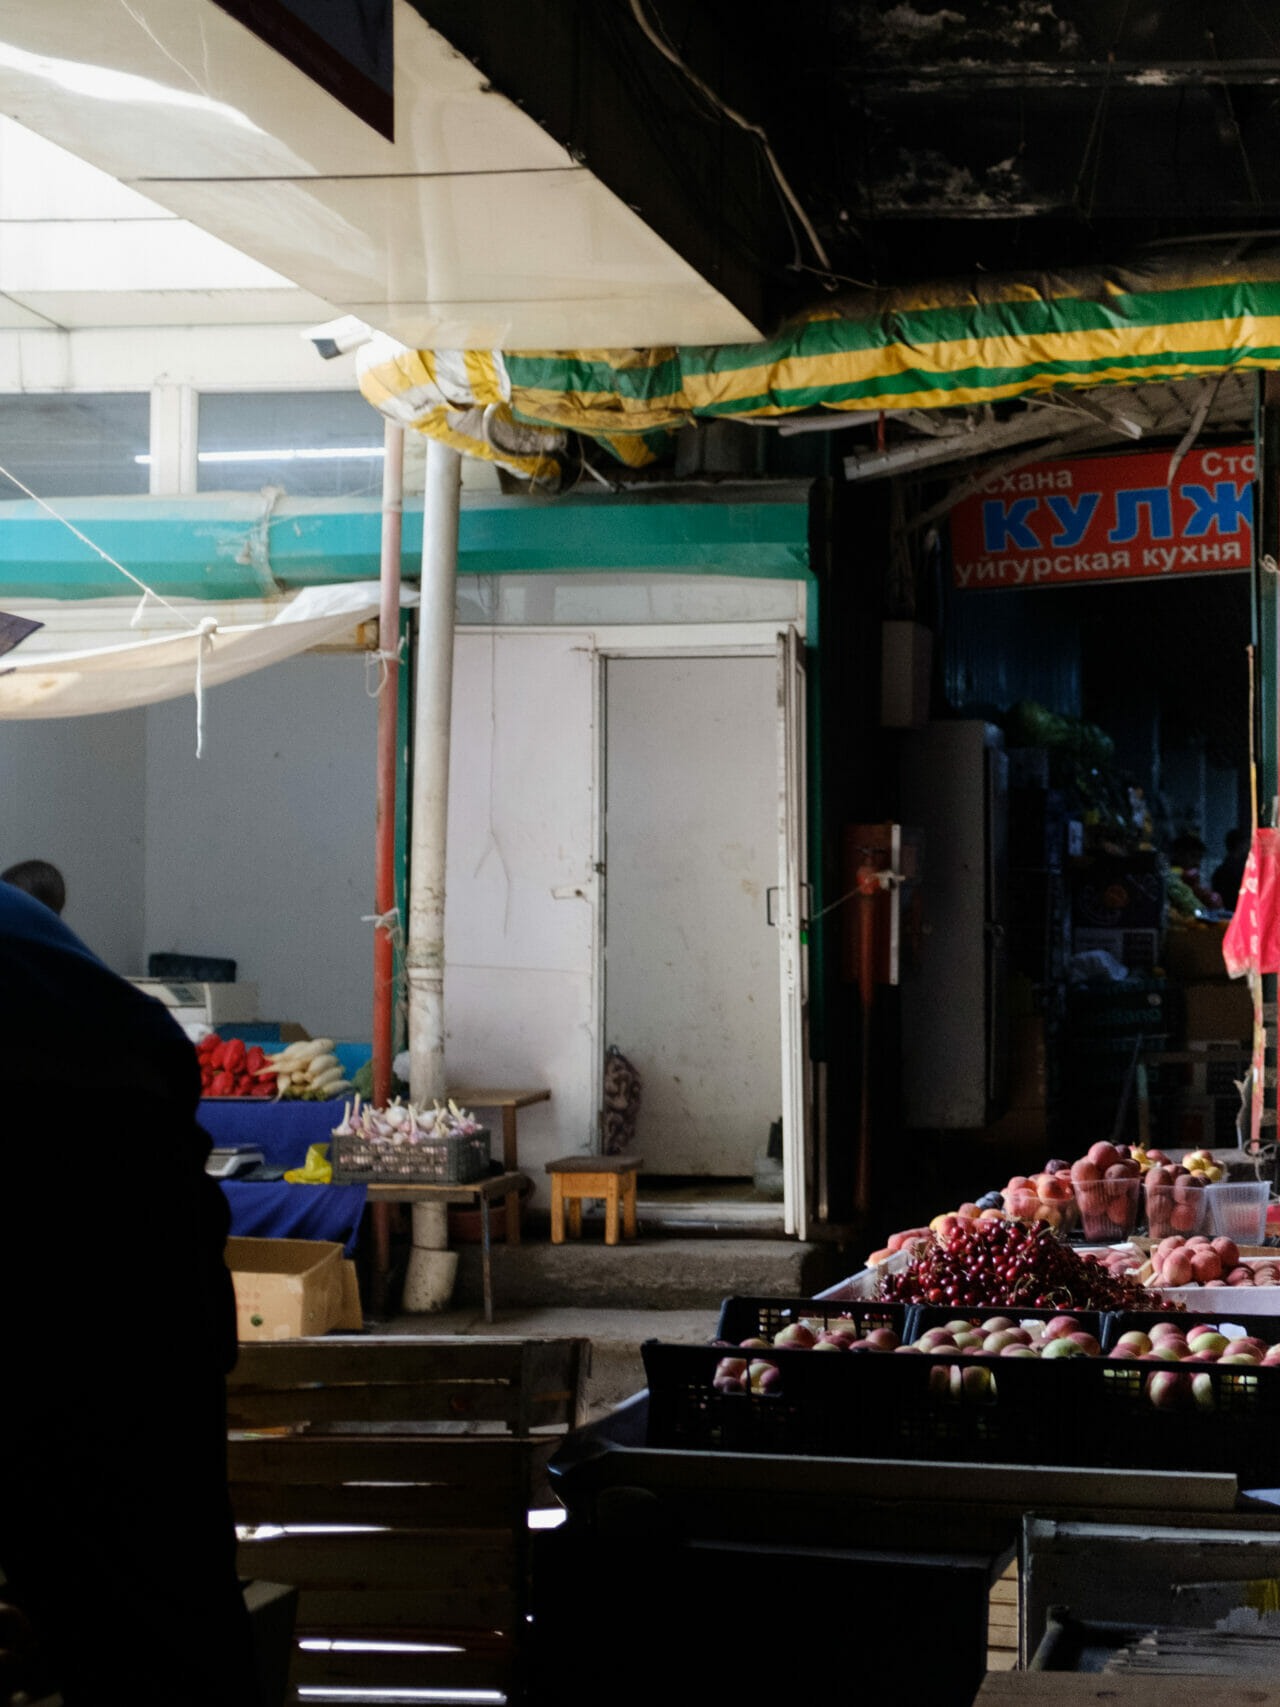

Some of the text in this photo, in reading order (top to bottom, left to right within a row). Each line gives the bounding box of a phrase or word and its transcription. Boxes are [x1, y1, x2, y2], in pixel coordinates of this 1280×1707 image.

[967, 469, 1073, 495] схана
[956, 541, 1242, 587] уйгурская кухня
